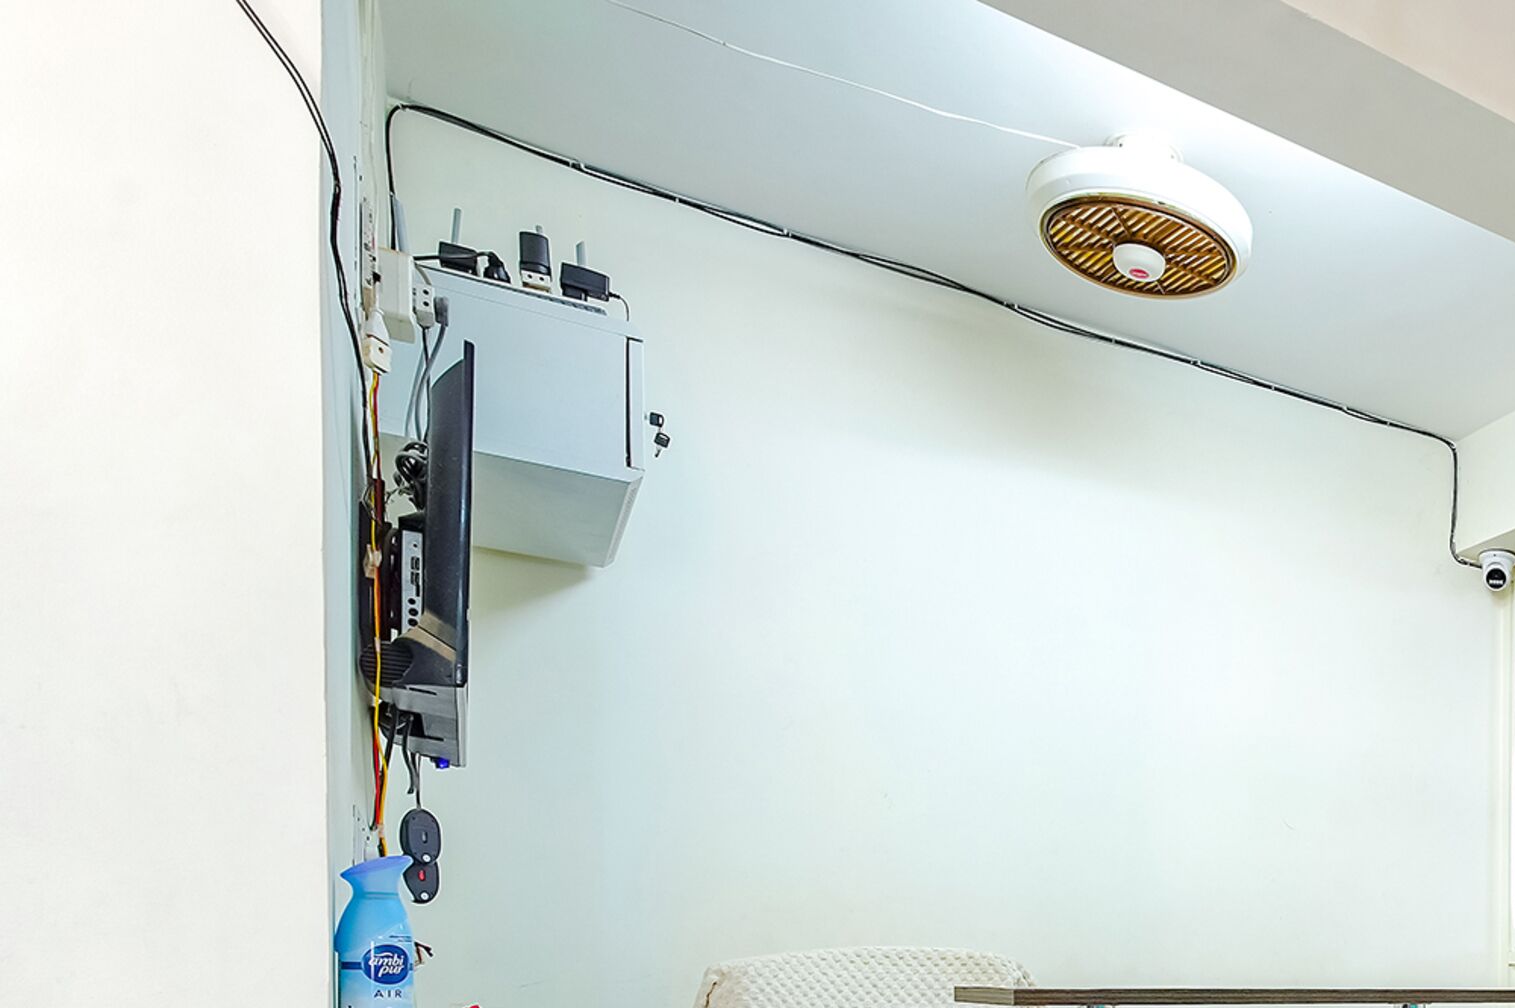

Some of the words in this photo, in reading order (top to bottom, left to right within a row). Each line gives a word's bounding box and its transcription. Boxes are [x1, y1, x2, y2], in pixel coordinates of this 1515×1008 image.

[369, 953, 404, 966] ambi
[378, 964, 404, 977] pur
[374, 989, 402, 998] AIR
